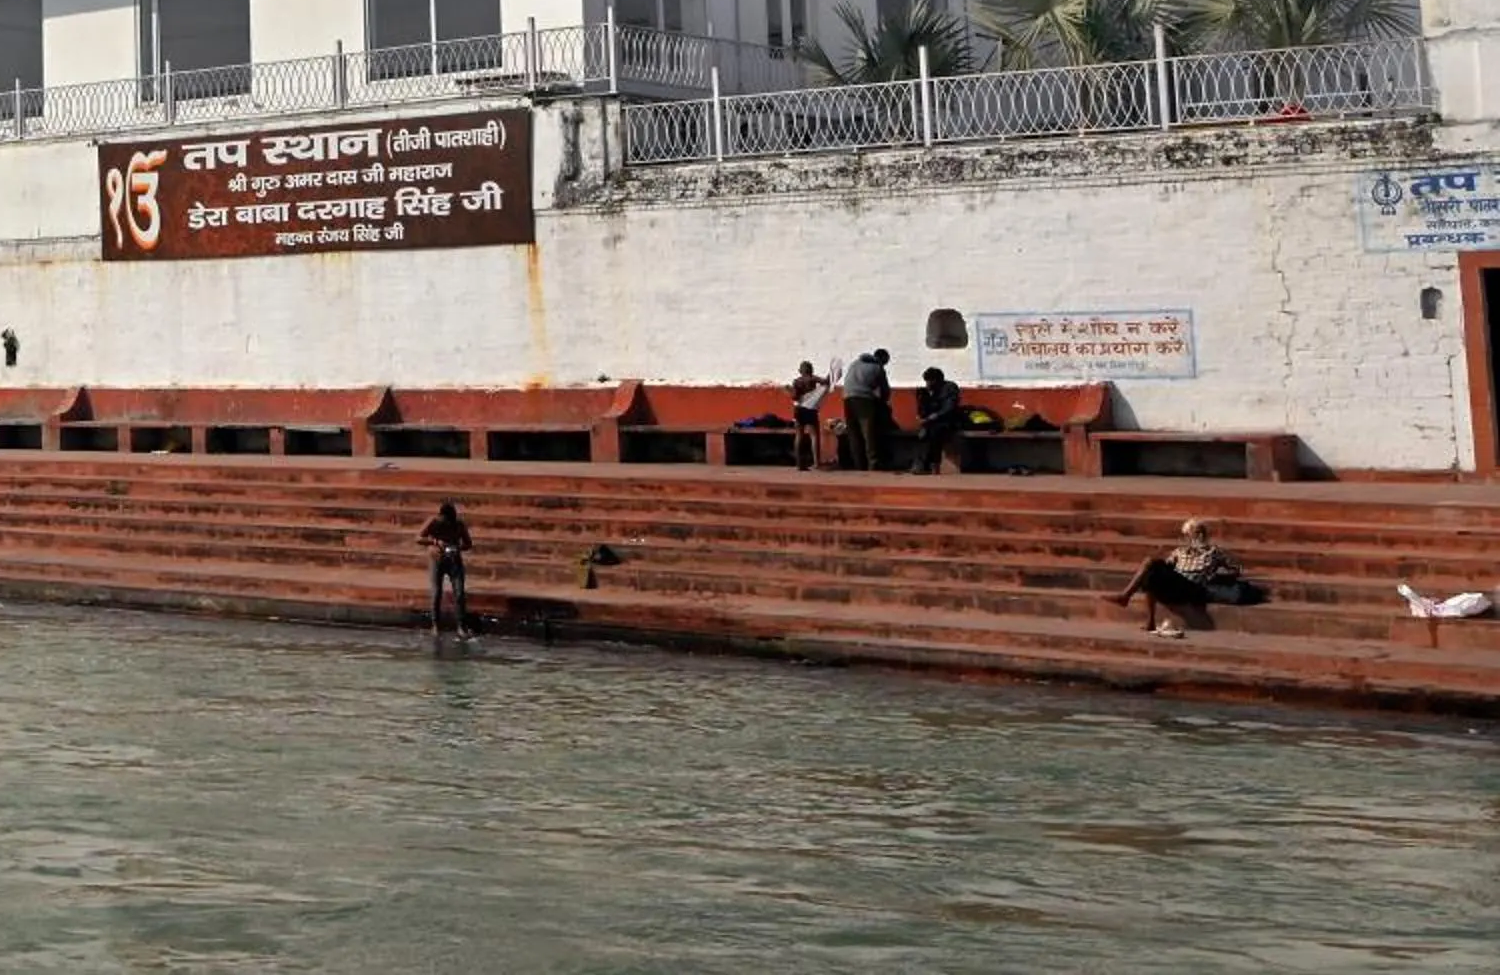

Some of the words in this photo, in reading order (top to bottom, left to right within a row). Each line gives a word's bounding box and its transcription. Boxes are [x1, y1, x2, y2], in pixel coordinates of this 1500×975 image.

[181, 138, 251, 170] तप
[259, 127, 383, 165] स्थान
[386, 126, 431, 159] (तीजी
[434, 118, 507, 150] पातशाही)
[227, 172, 247, 193] श्री
[250, 176, 281, 198] गुरु
[284, 171, 323, 189] अमर
[326, 169, 358, 187] दास
[362, 162, 385, 183] जी
[388, 162, 453, 181] महाराज
[1410, 172, 1481, 198] तप
[187, 201, 229, 230] डेरा
[234, 202, 291, 224] बाबा
[296, 196, 388, 221] दरगाह
[394, 186, 454, 216] सिंह
[459, 180, 505, 211] जी
[352, 223, 381, 242] सिंह
[384, 222, 405, 241] जी
